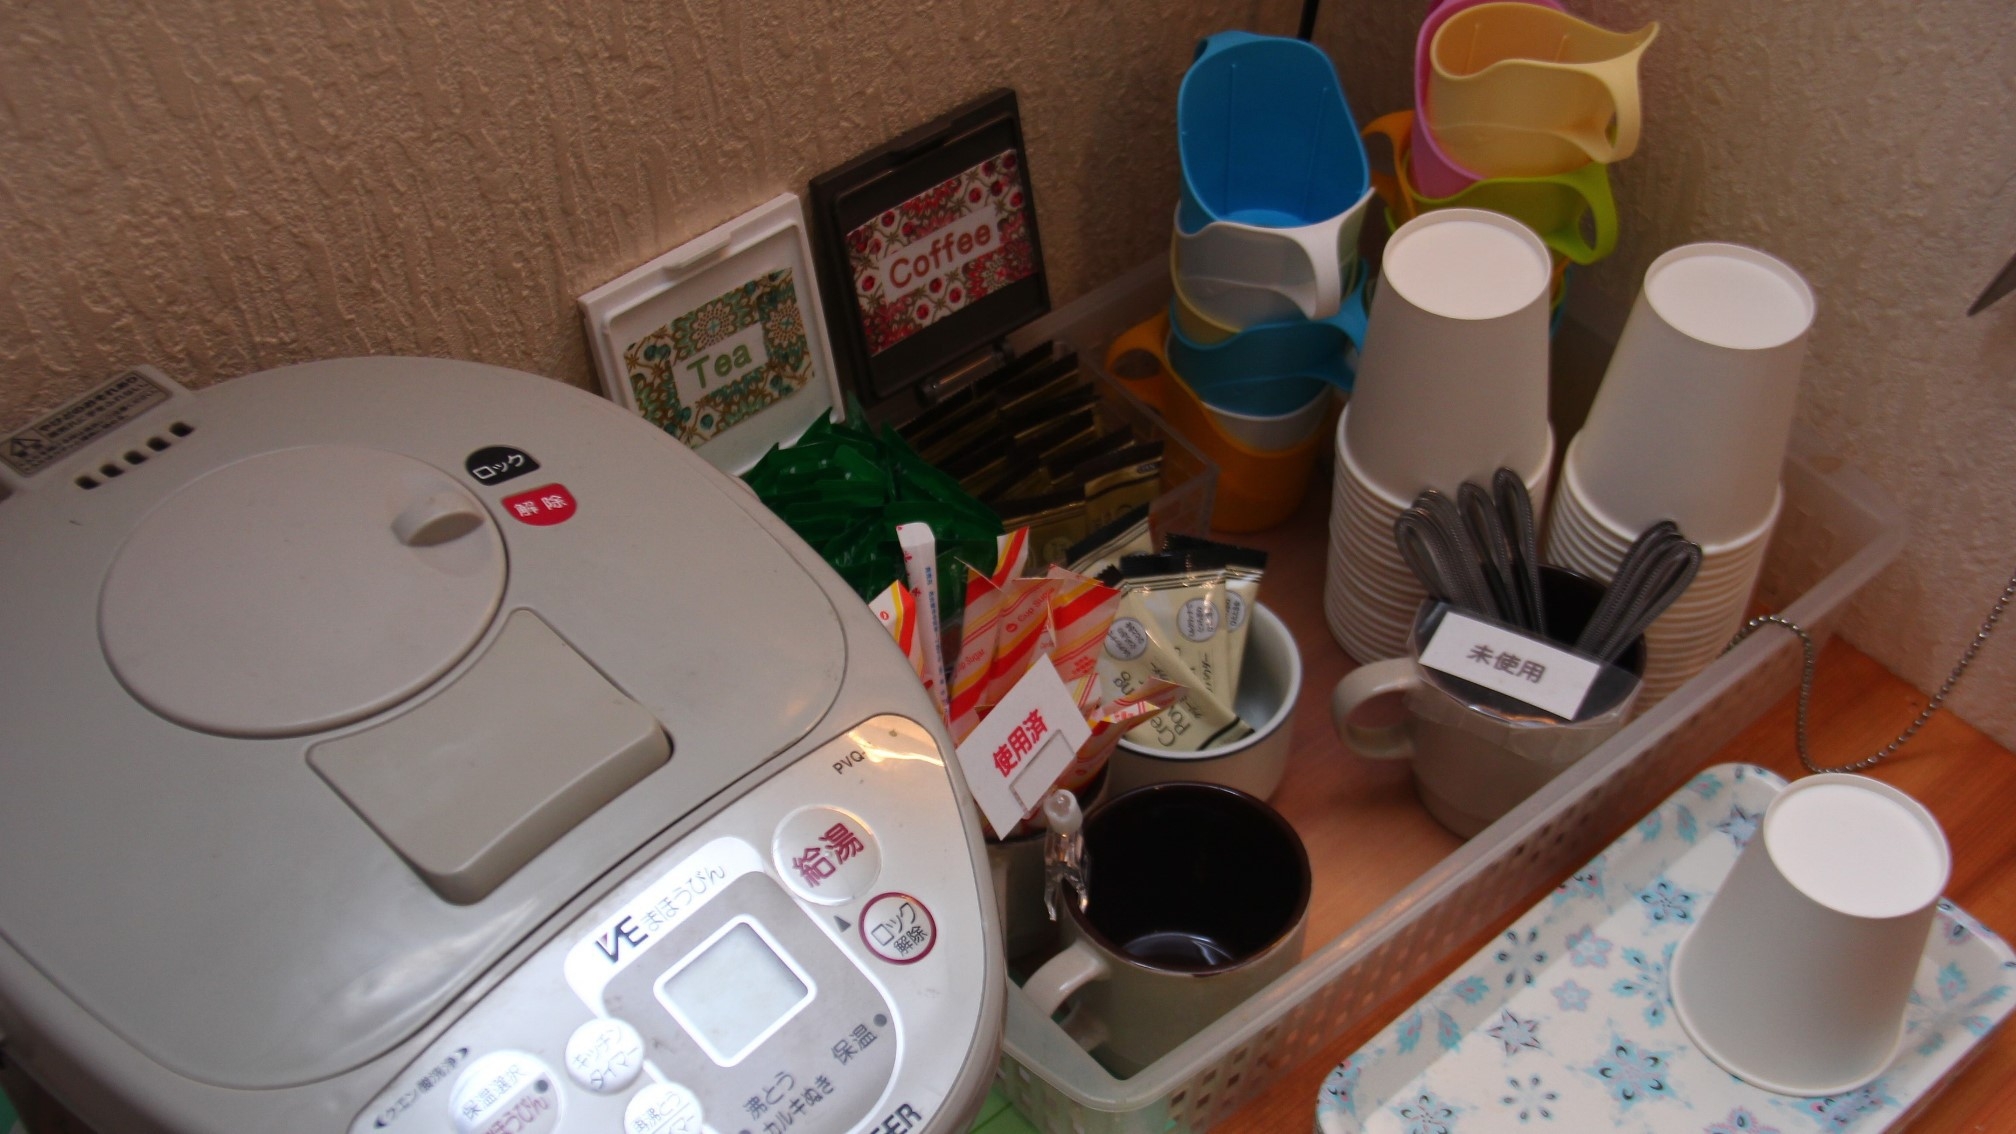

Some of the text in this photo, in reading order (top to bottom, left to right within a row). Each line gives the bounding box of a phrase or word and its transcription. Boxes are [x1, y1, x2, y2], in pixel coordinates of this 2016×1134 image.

[887, 221, 992, 290] Coffee
[686, 342, 753, 390] Tea
[472, 453, 525, 480] ロック
[513, 494, 568, 518] 解除
[1466, 643, 1547, 685] 未使用
[992, 708, 1049, 779] 使用済
[791, 821, 865, 889] 給湯
[640, 865, 726, 932] まほうびん
[870, 901, 916, 947] ロック
[893, 925, 928, 957] 解除
[588, 1046, 639, 1091] タイマー
[830, 1023, 878, 1066] 保温
[461, 1063, 528, 1121] 保温選択
[742, 1070, 796, 1121] 沸とう
[763, 1074, 835, 1134] カルキぬき
